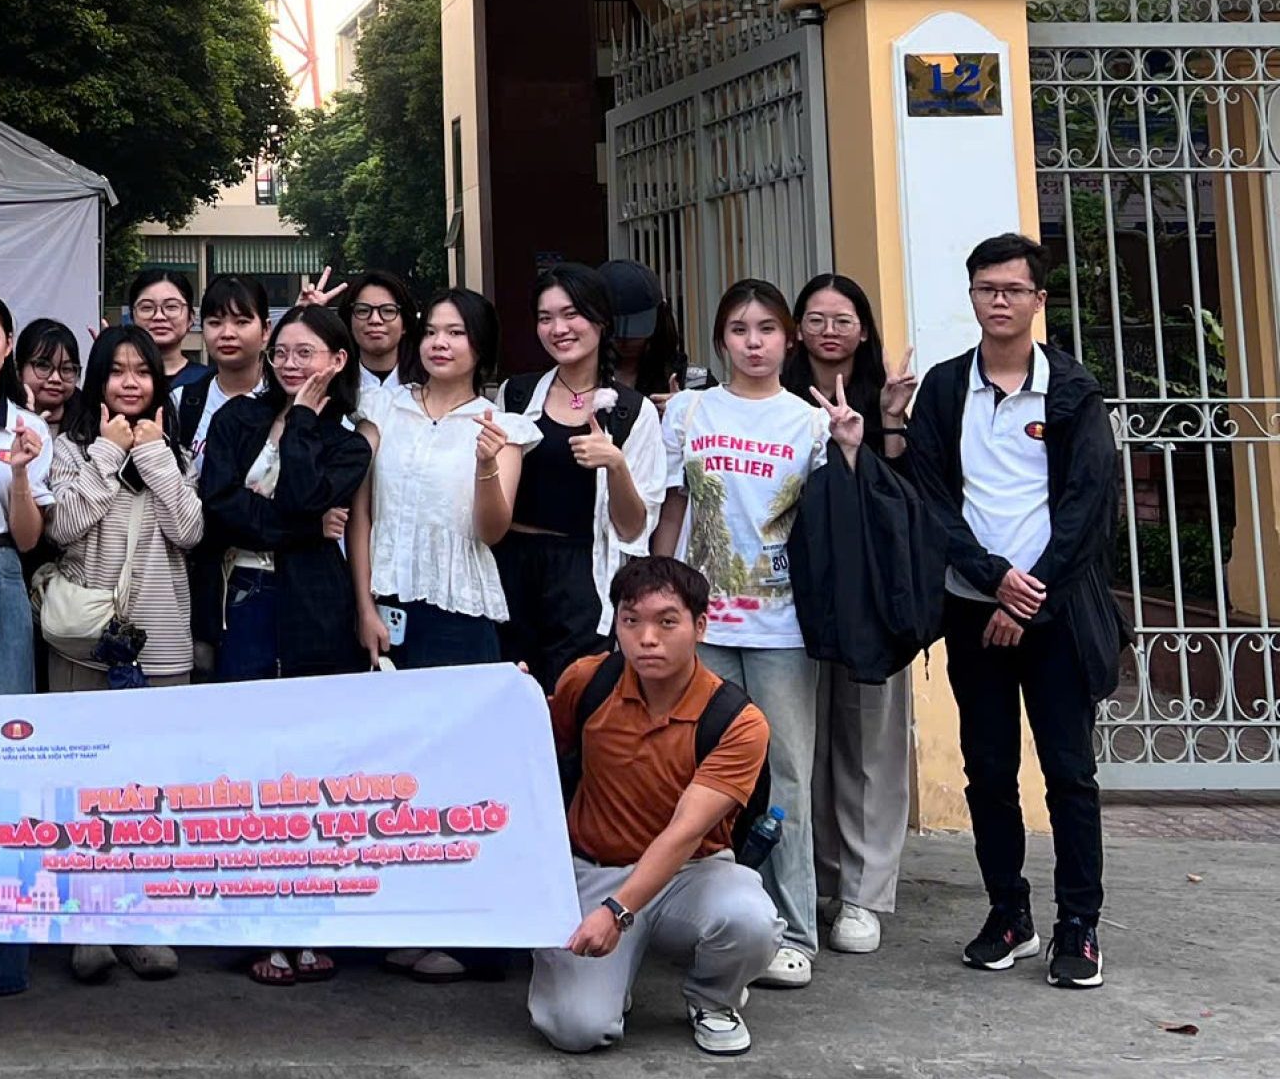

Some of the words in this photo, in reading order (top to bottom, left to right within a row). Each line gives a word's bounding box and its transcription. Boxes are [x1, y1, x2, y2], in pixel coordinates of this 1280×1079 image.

[929, 62, 980, 95] 12
[690, 434, 795, 460] WHENEVER
[704, 455, 775, 479] ATELIER
[79, 783, 160, 812] PHÁT
[165, 775, 252, 808] TRIỂN
[324, 772, 419, 803] VỮNG
[64, 816, 106, 849] VỆ
[112, 816, 175, 845] MÔI
[182, 810, 311, 842] TRƯỜNG
[317, 810, 368, 842] TẠI
[375, 802, 440, 834] CẦN
[447, 800, 509, 832] GIỜ
